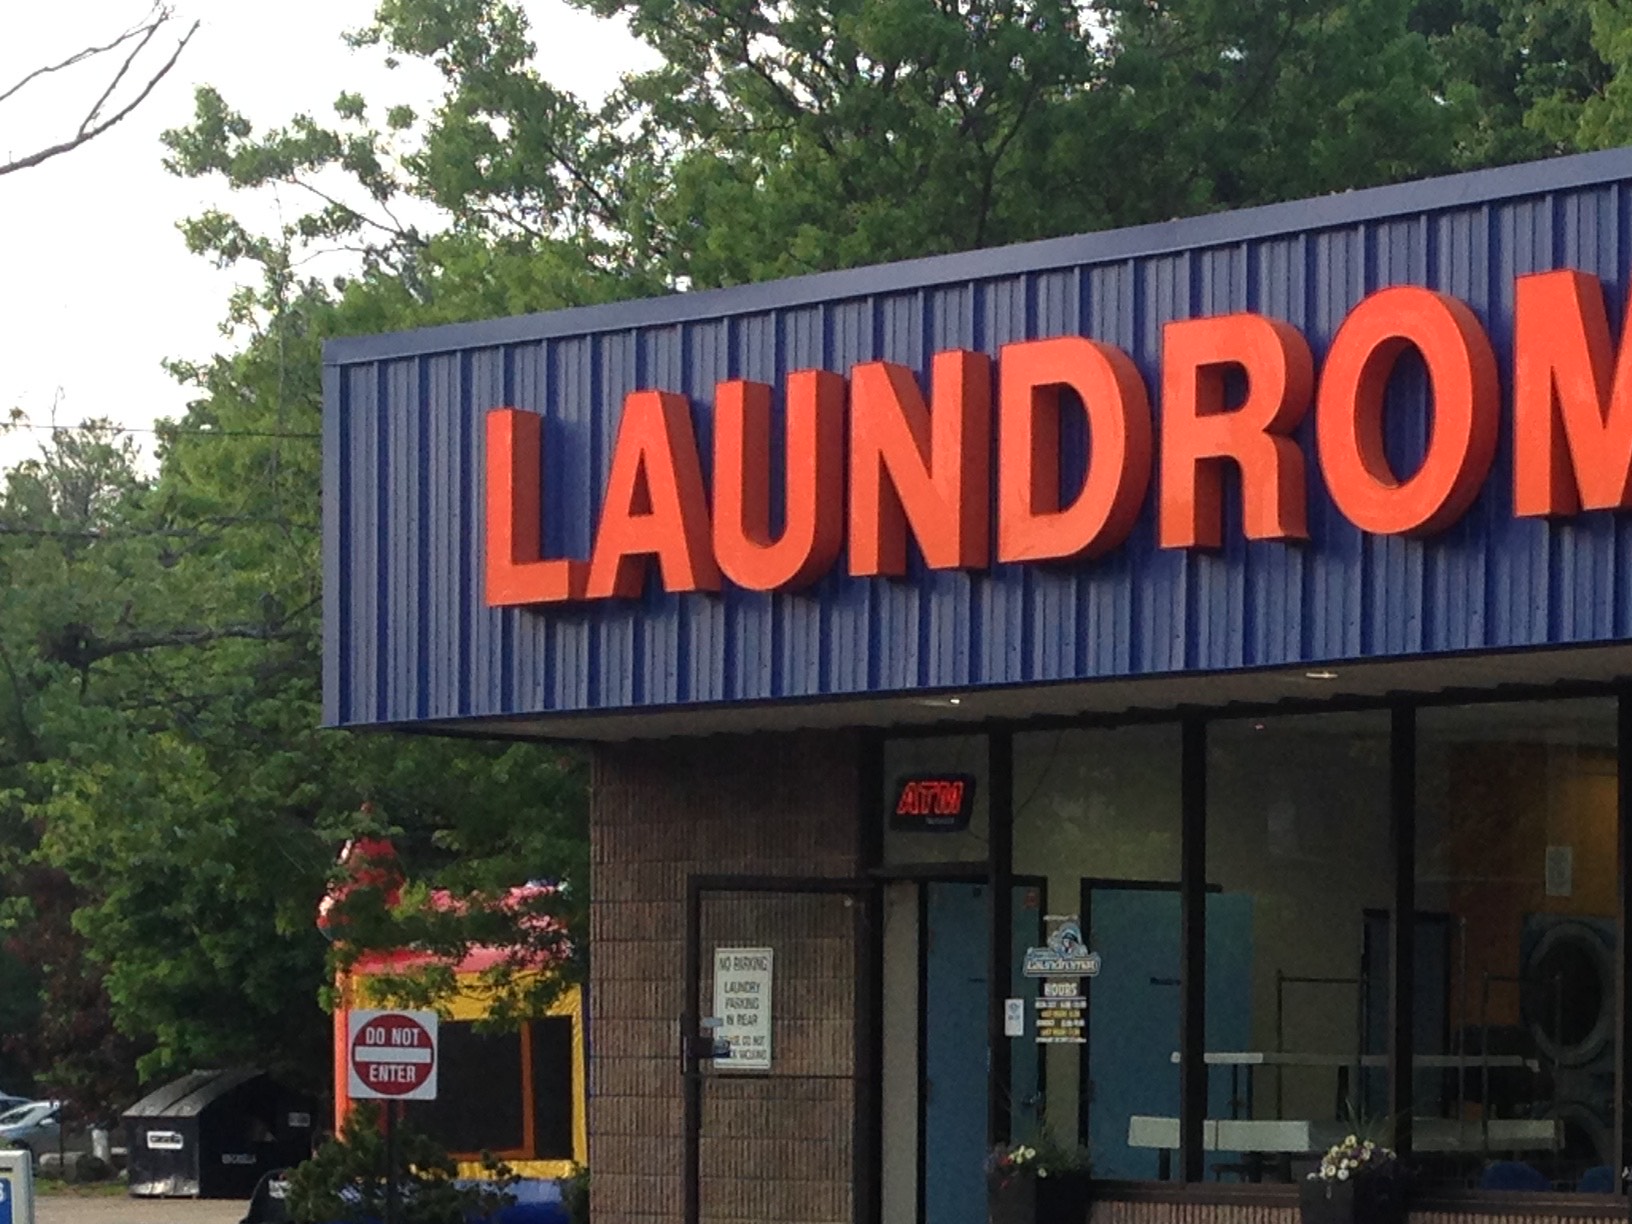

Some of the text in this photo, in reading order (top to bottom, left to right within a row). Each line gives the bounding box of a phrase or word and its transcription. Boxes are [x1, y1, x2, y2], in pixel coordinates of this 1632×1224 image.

[896, 781, 963, 815] ATM
[724, 981, 760, 993] LAUNDRY
[1044, 983, 1077, 996] HOURS
[737, 1014, 758, 1026] REAR
[366, 1027, 421, 1046] DO NOT
[369, 1064, 416, 1083] ENTER
